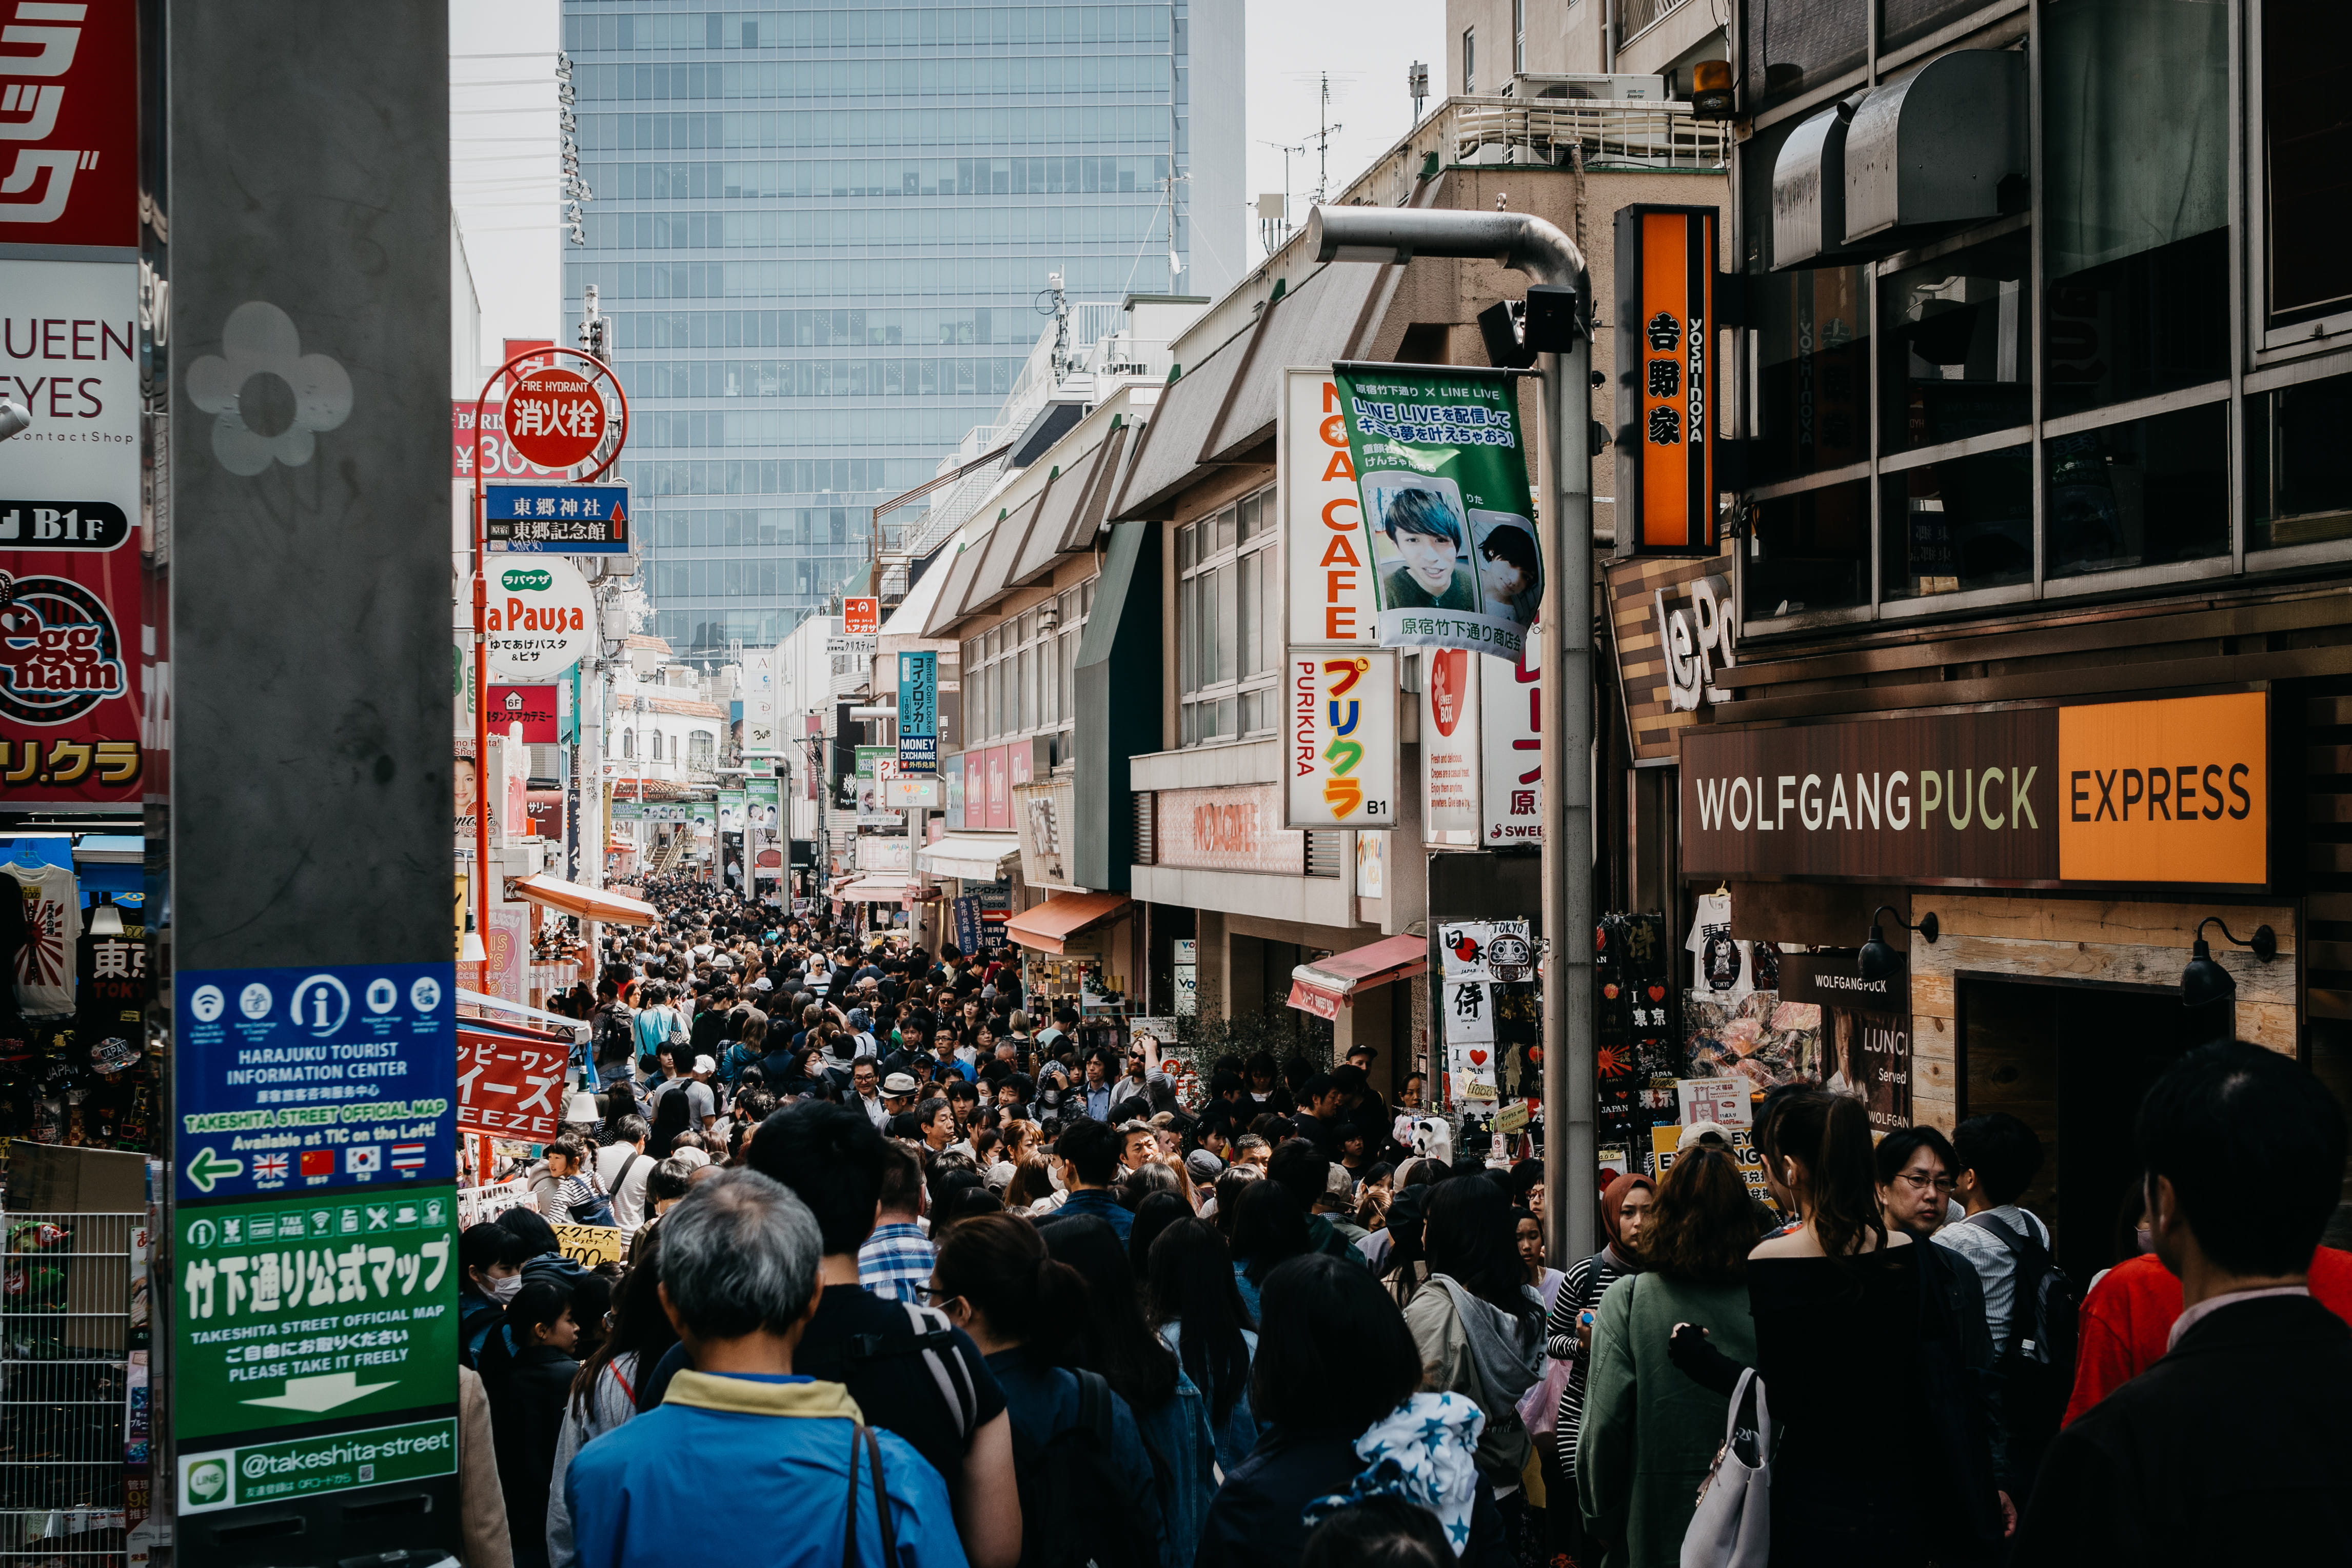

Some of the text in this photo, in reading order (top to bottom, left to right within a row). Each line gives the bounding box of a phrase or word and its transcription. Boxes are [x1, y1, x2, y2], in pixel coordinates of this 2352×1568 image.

[0, 317, 133, 363] UEEN
[521, 381, 588, 393] FIRE HYDRANT
[1689, 319, 1703, 443] YOSHINOYA
[1355, 383, 1500, 400] 原宿竹下通り LINE LIVE
[513, 399, 599, 438] 消火栓
[1353, 398, 1395, 421] LINE
[1358, 418, 1515, 446] キミも夢を叶えちゃおう!
[513, 497, 602, 517] 東郷神社
[1466, 493, 1484, 505] りた
[513, 521, 606, 541] 東郷記念館
[1319, 498, 1362, 640] CAFE
[503, 573, 551, 586] ラパウザ
[507, 597, 584, 634] Pausa
[852, 624, 877, 632] アガサ
[1401, 618, 1522, 653] 原宿竹下通り商店会
[490, 639, 567, 650] ゆであげパスタ
[845, 641, 875, 652] クリスティー
[508, 699, 520, 708] 6F
[913, 658, 924, 733] コインロッカー
[1296, 662, 1315, 777] PURIKURA
[1440, 706, 1453, 723] BOX
[901, 739, 935, 750] MONEY
[1322, 656, 1371, 821] プリクラ
[901, 751, 936, 760] EXCHANGE
[1431, 753, 1440, 764] Fresh
[2070, 762, 2251, 823] EXPRESS
[1367, 800, 1387, 815] B1
[1492, 922, 1524, 934] TOKYO
[1454, 981, 1484, 1018] 侍
[1631, 990, 1638, 1003] I
[1632, 1006, 1666, 1027] 東京
[103, 1042, 127, 1060] JAPAN
[1864, 1027, 1908, 1057] LUNC
[239, 1042, 399, 1065] HARAJUKU TOURIST
[1453, 1049, 1461, 1061] I
[46, 1063, 79, 1081] JAPAN
[227, 1061, 408, 1085] INFORMATION CENTER
[1650, 1070, 1673, 1079] JAPAN
[1878, 1067, 1907, 1084] Served
[184, 1098, 448, 1134] TAKESHITA STREET OFFICIAL MAP
[1601, 1104, 1629, 1114] JAPAN
[231, 1121, 437, 1152] Available at TIC on the Left!
[279, 1224, 305, 1236] FREE
[281, 1215, 302, 1226] TAX
[557, 1226, 618, 1240] スクイーズ
[184, 1233, 451, 1320] 竹下通り公式マップ
[190, 1304, 445, 1344] TAKESHITA STREET OFFICIAL MAP
[225, 1329, 409, 1364] ご自由にお取りください
[229, 1347, 409, 1383] PLEASE TAKE IT FREELY
[242, 1431, 450, 1479] @takeshita-street
[195, 1473, 221, 1486] LINE
